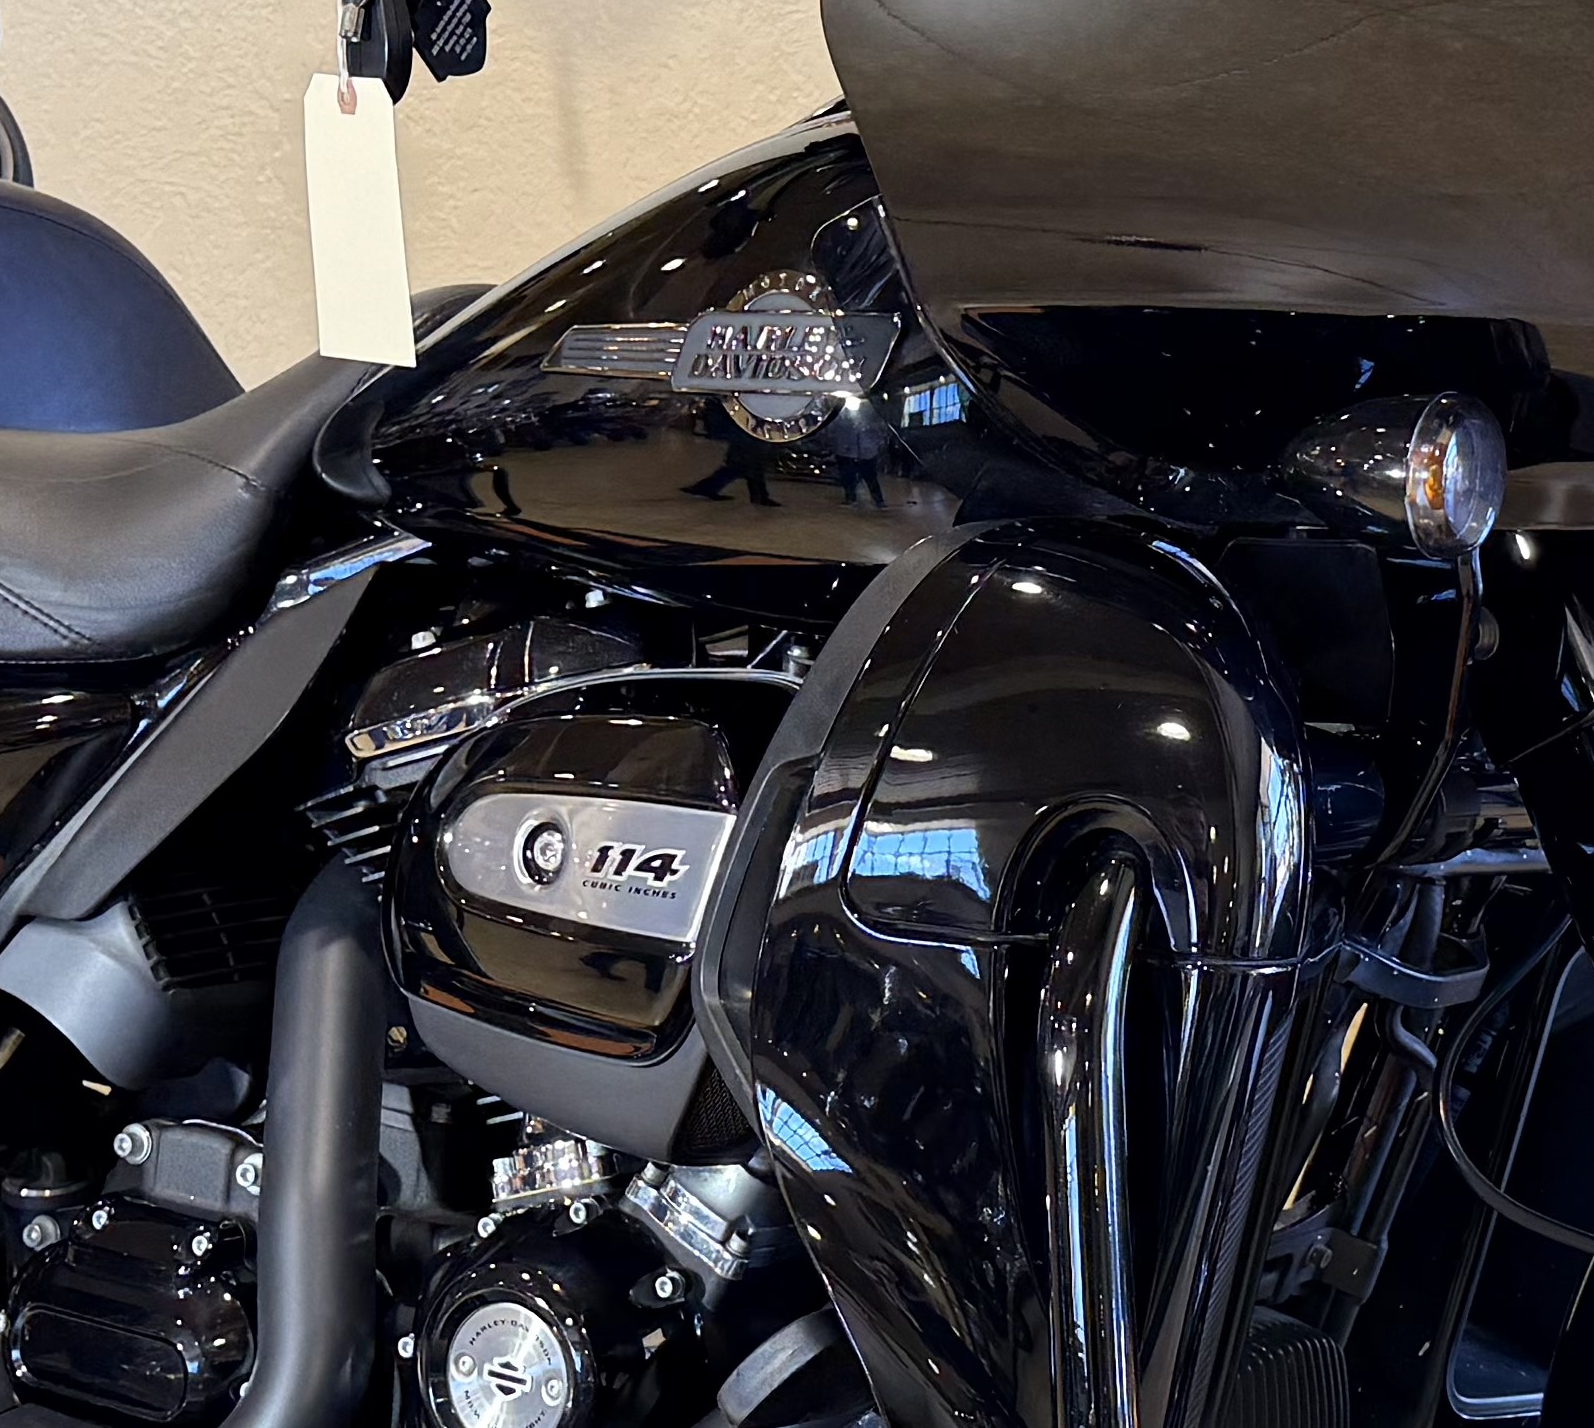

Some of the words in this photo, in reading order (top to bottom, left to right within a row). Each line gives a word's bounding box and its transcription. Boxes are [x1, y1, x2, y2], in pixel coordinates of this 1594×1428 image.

[588, 841, 690, 888] 114
[582, 879, 622, 893] CUBIC
[628, 885, 677, 900] INCHES
